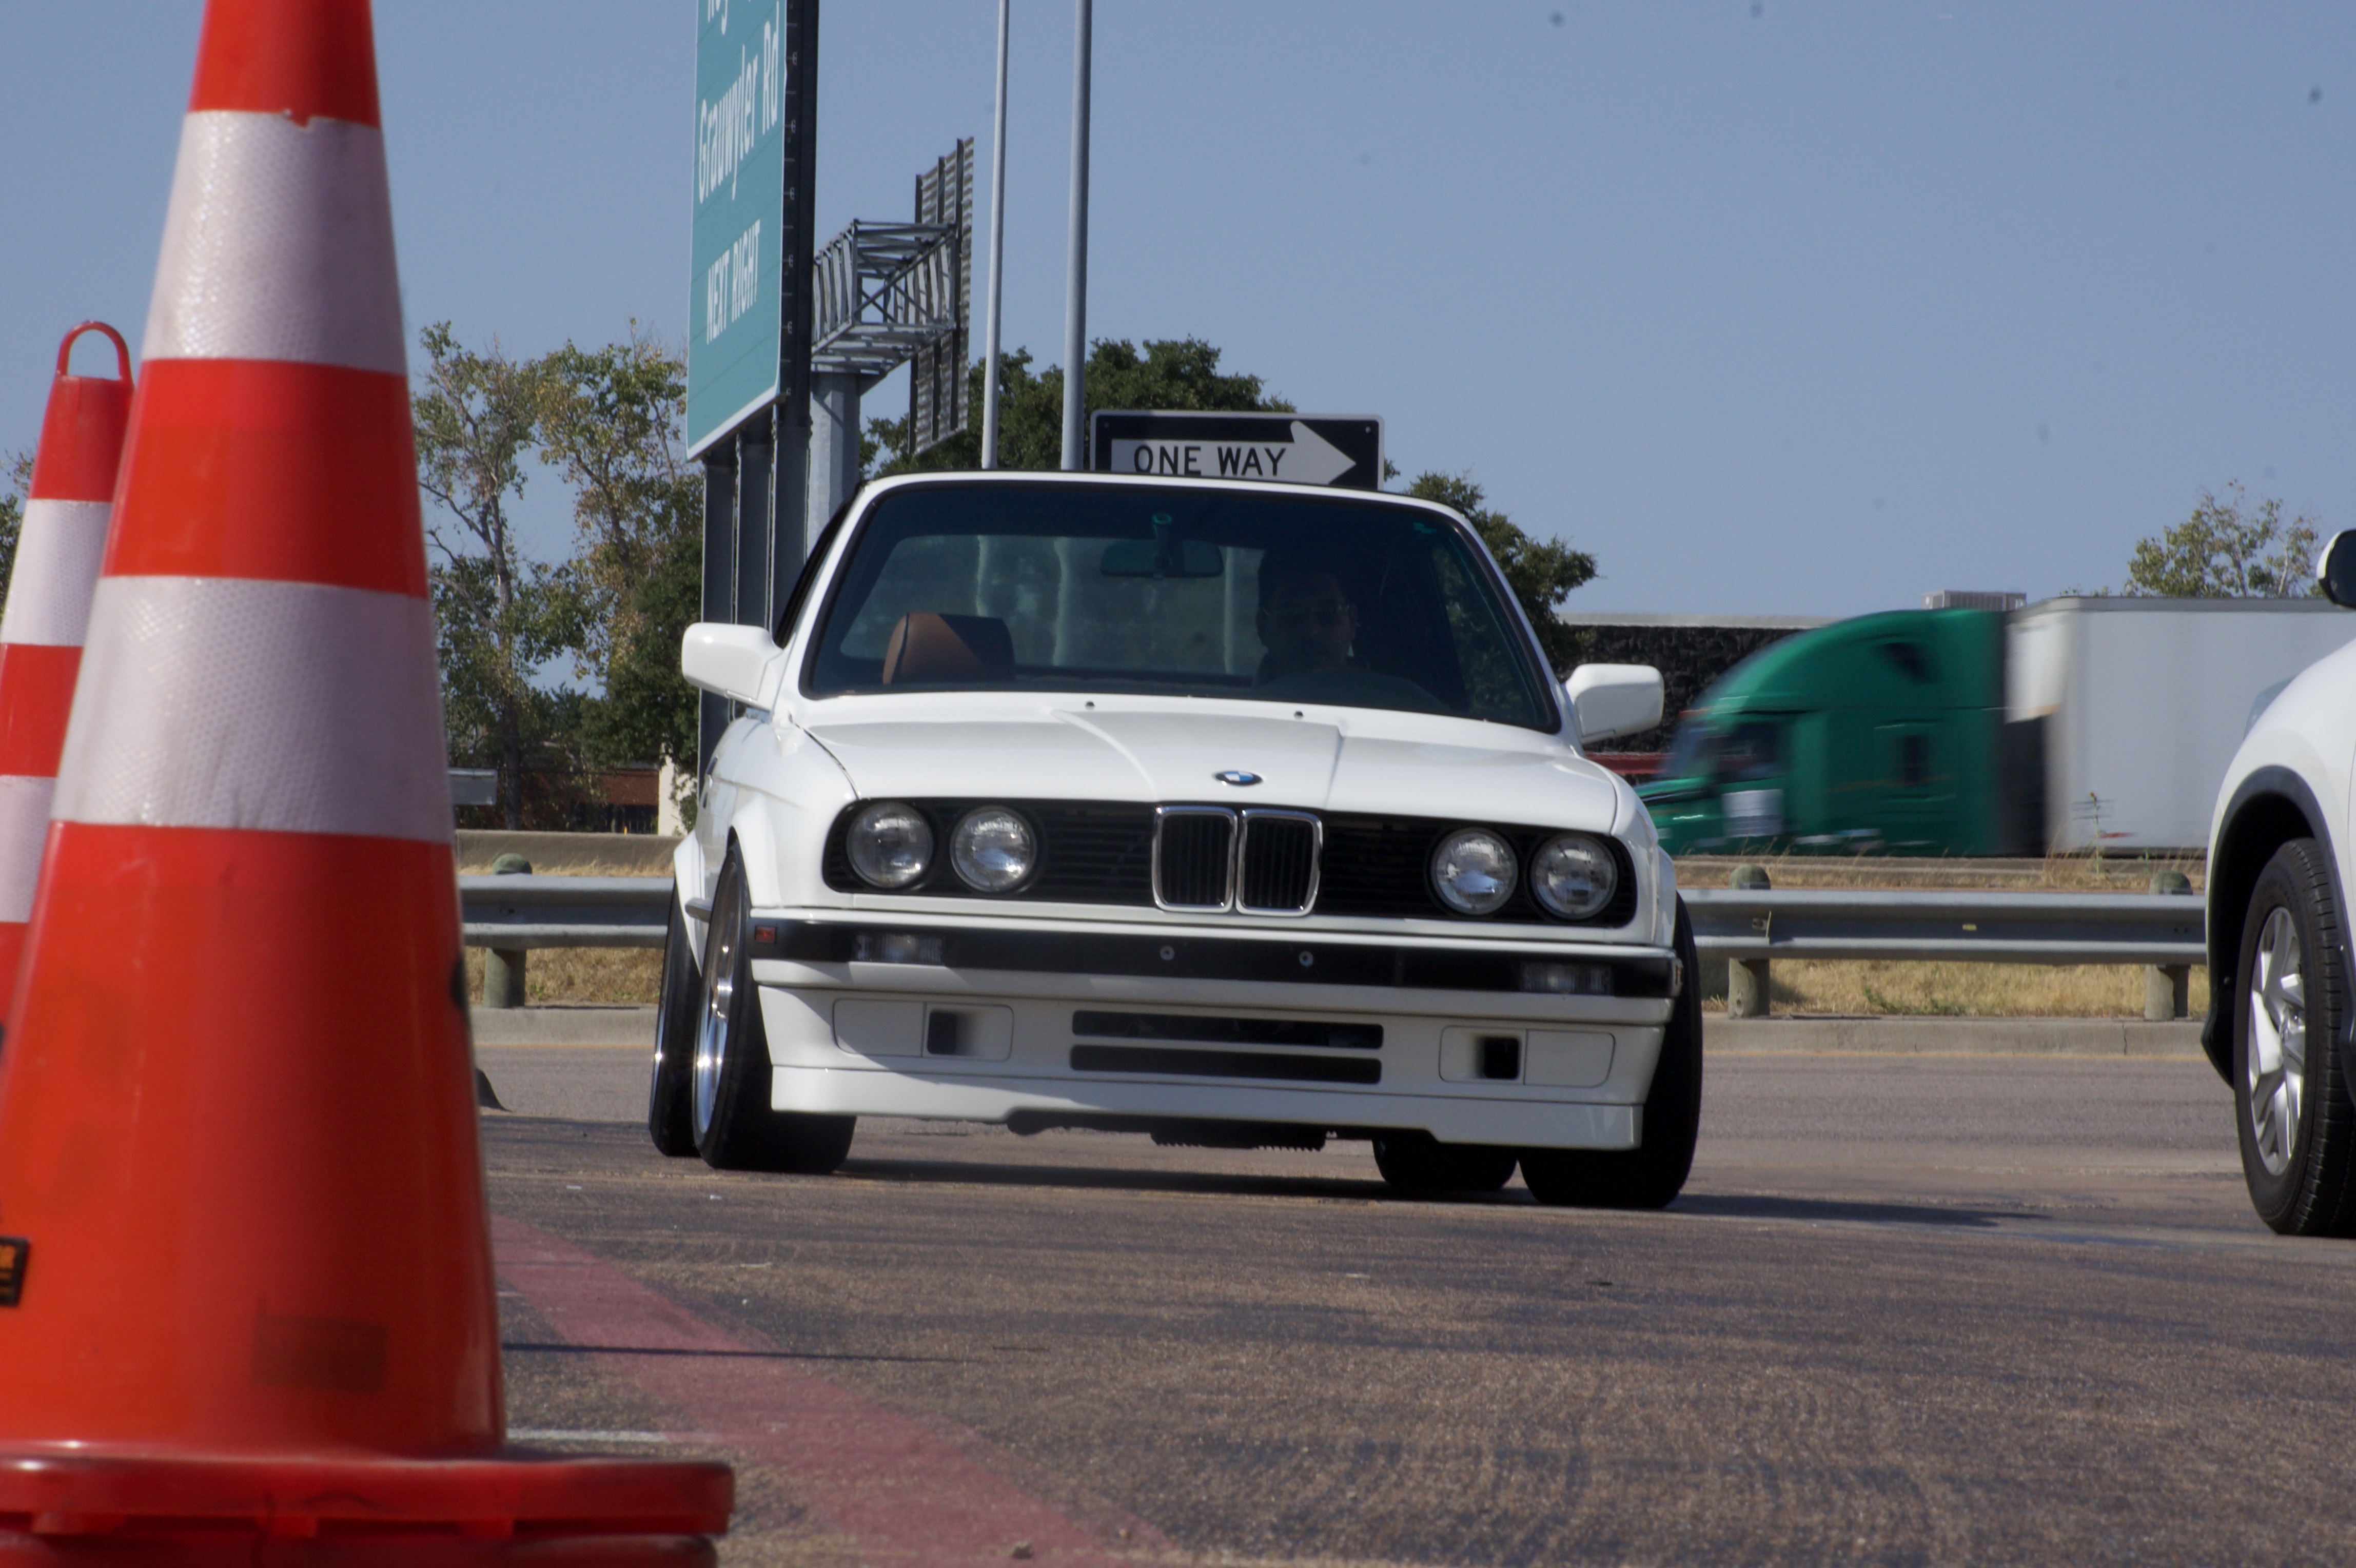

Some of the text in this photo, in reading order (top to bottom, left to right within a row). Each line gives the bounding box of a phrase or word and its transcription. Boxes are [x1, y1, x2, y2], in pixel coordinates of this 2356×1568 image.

[698, 44, 758, 204] Grauwyler
[762, 1, 780, 135] Rd
[706, 219, 760, 344] NEXT RIGHT
[1134, 445, 1286, 477] ONE WAY
